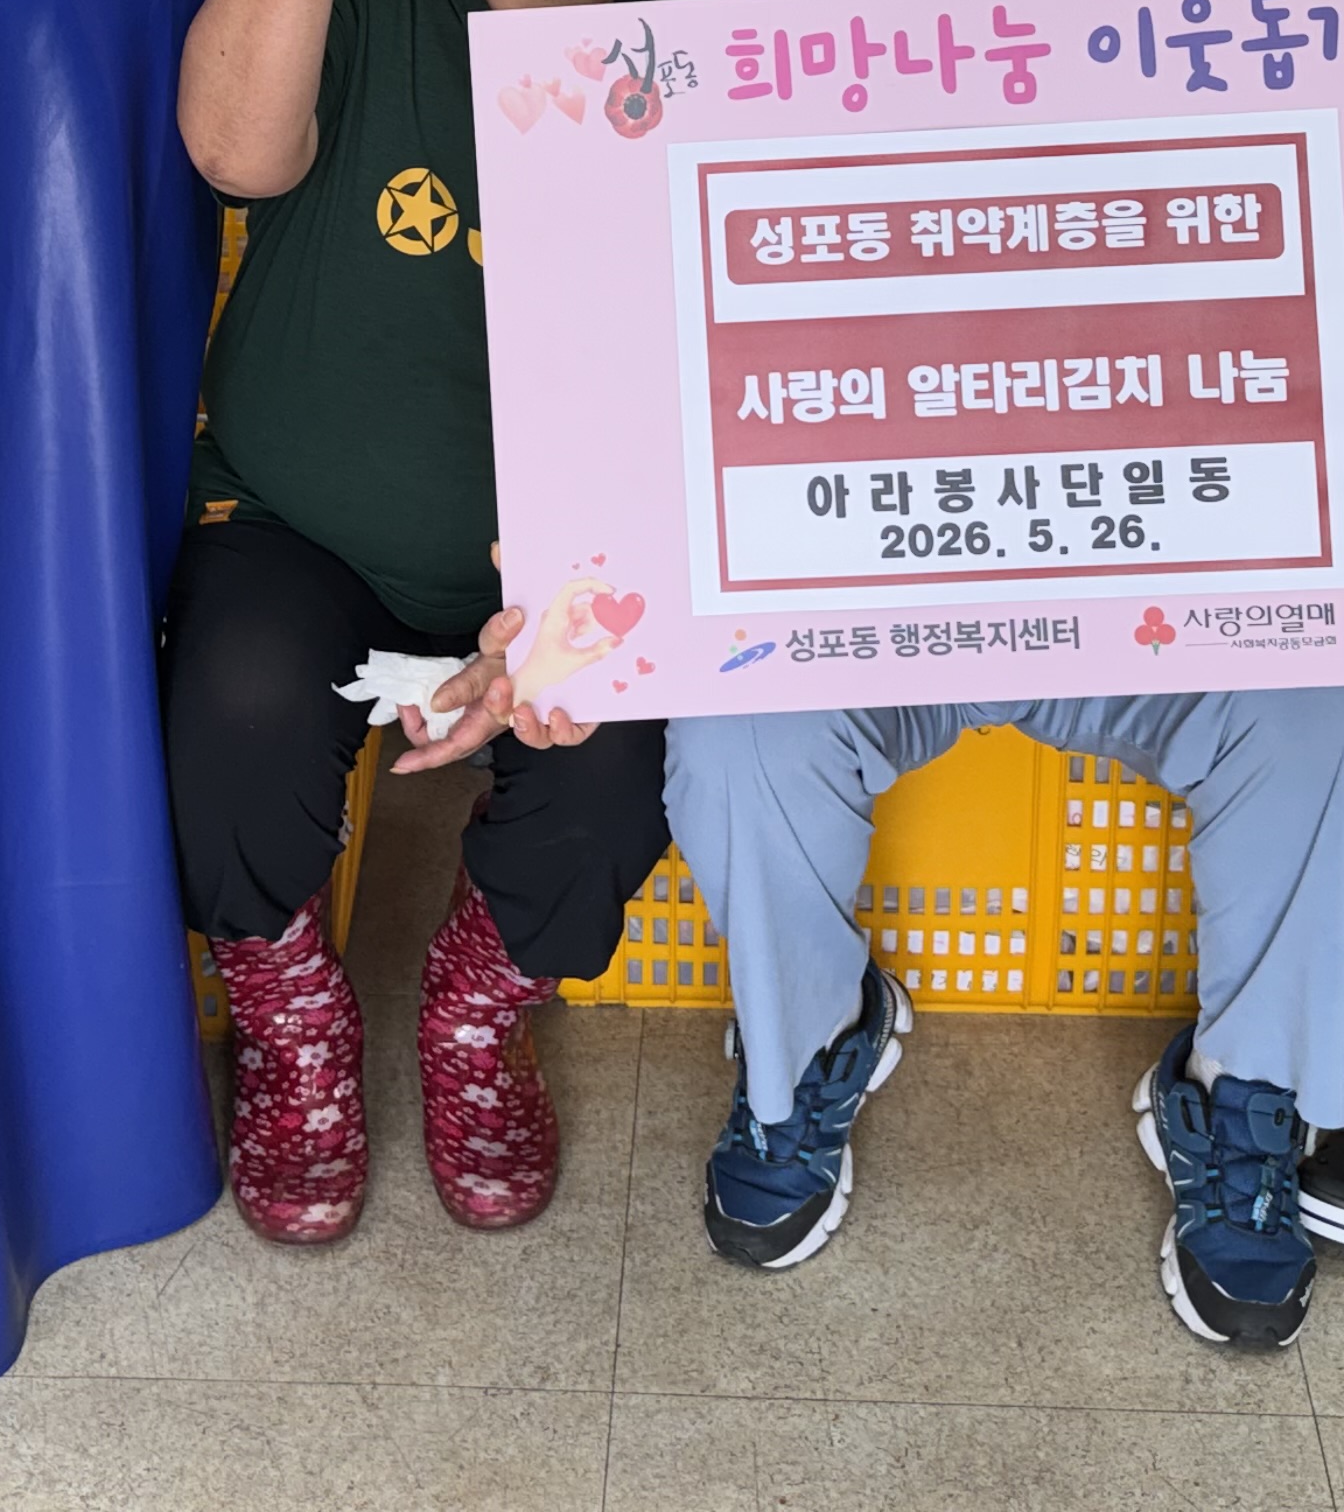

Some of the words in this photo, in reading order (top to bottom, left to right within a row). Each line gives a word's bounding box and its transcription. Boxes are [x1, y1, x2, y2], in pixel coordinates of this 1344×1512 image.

[724, 4, 1052, 113] 희망나눔
[750, 210, 893, 267] 성포동
[909, 197, 1148, 259] 취약계층을
[1165, 192, 1263, 248] 위한
[737, 367, 887, 425] 사랑의
[907, 354, 1164, 420] 알타리김치
[1188, 349, 1290, 403] 나눔
[880, 519, 1007, 561] 2026.
[1027, 518, 1070, 556] 5.
[1090, 514, 1163, 554] 26.
[784, 625, 880, 662] 성포동
[890, 615, 1083, 658] 행정복지센터
[1183, 602, 1336, 637] 사랑의열매
